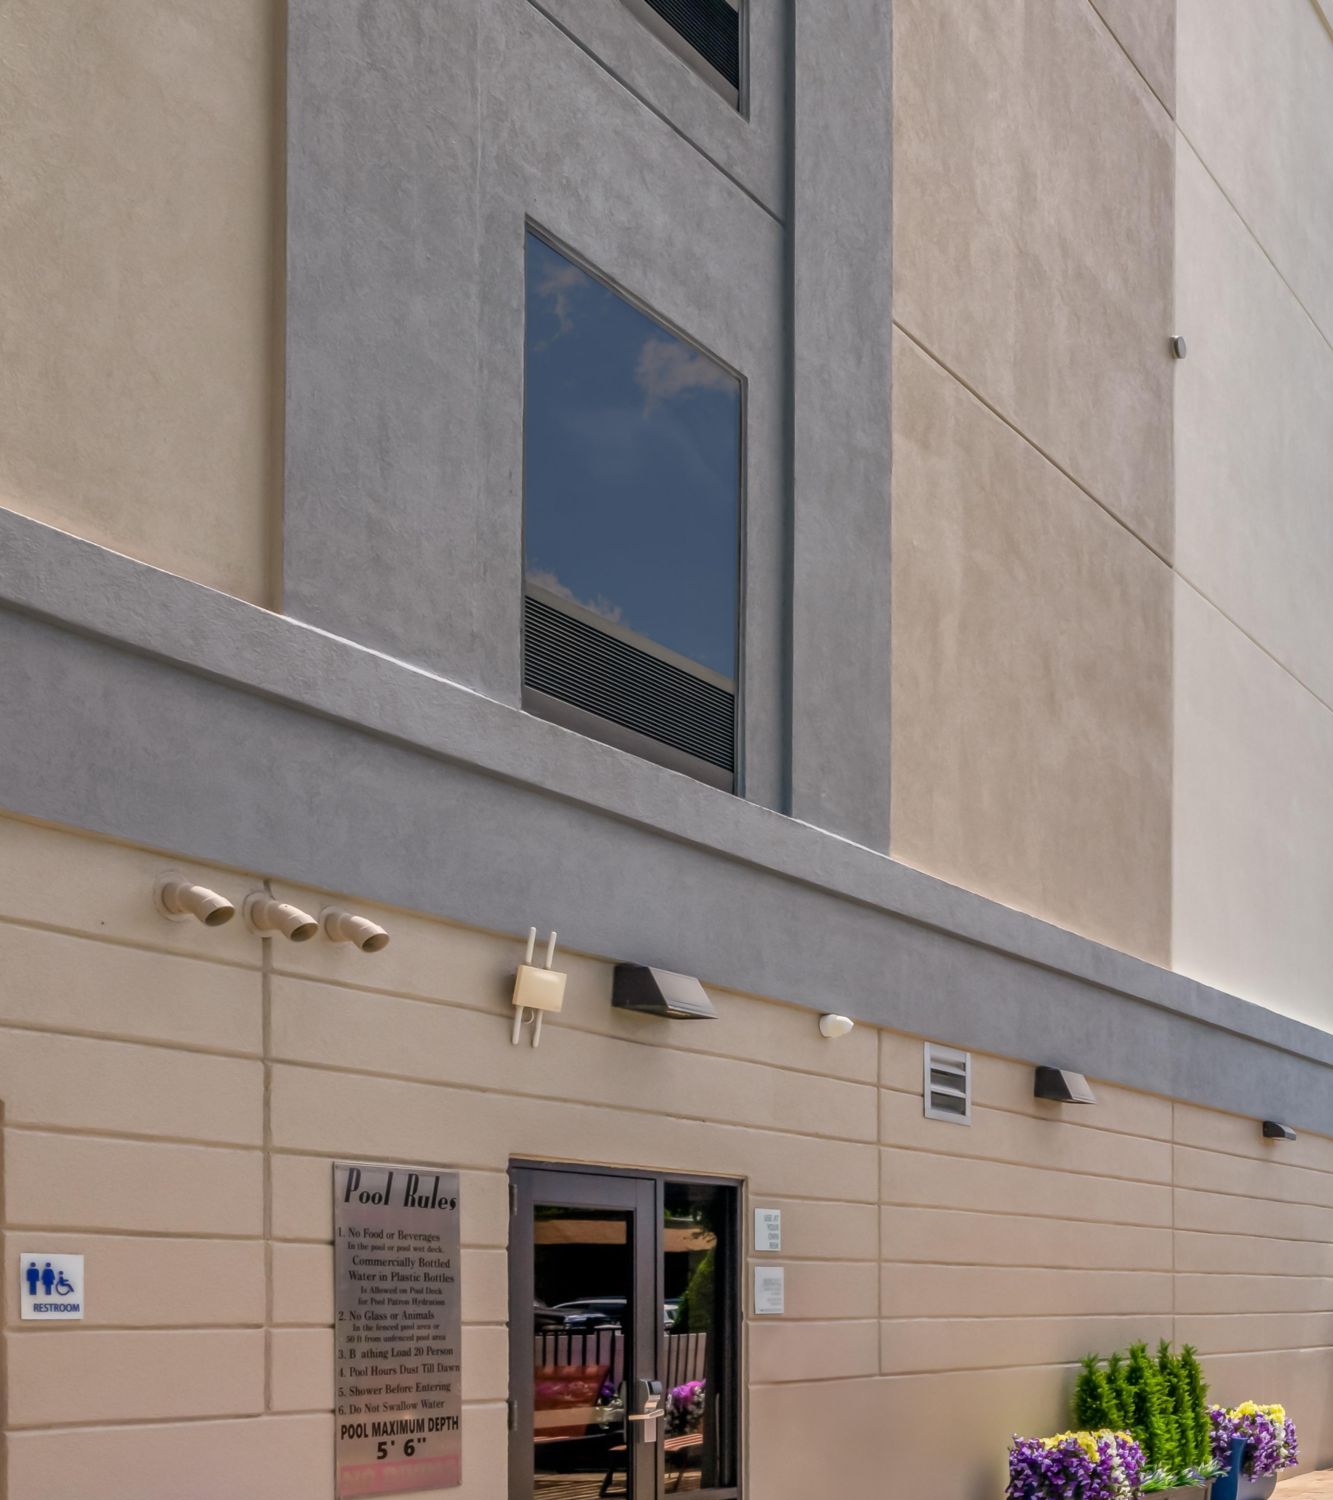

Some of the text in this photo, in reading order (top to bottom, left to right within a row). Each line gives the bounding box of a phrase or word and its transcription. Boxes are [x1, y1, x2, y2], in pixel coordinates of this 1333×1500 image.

[344, 1167, 457, 1211] Pool Rules
[348, 1228, 360, 1238] No
[363, 1228, 384, 1240] Food
[386, 1232, 395, 1240] or
[398, 1230, 440, 1242] Beverages
[348, 1242, 356, 1250] In
[358, 1242, 368, 1250] the
[370, 1243, 386, 1252] pool
[396, 1244, 411, 1252] pool
[352, 1255, 450, 1269] Commercially Bottled
[348, 1270, 455, 1283] Water in Plastic Bottles
[360, 1286, 368, 1294] Is
[370, 1286, 398, 1294] Allowed
[410, 1286, 424, 1294] Pool
[426, 1287, 442, 1295] Deck
[34, 1303, 80, 1312] RESTROOM
[358, 1297, 368, 1305] for
[370, 1297, 386, 1306] Pool
[338, 1311, 347, 1321] 2.
[348, 1311, 362, 1320] No
[364, 1310, 388, 1320] Glass
[402, 1310, 435, 1320] Animals
[352, 1324, 360, 1332] In
[376, 1323, 399, 1331] fenced
[400, 1323, 415, 1332] pool
[416, 1334, 430, 1342] pool
[338, 1349, 346, 1360] 3.
[391, 1347, 412, 1358] Load
[414, 1347, 424, 1356] 20
[426, 1346, 454, 1356] Person
[339, 1362, 460, 1378] 4. Pool Hours Dust Till Dawn
[338, 1382, 452, 1398] 5. Shower Before Entering
[338, 1400, 445, 1416] 6. Do Not Swallow Water
[341, 1416, 459, 1440] POOL MAXIMUM DEPTH
[376, 1440, 396, 1460] 5'
